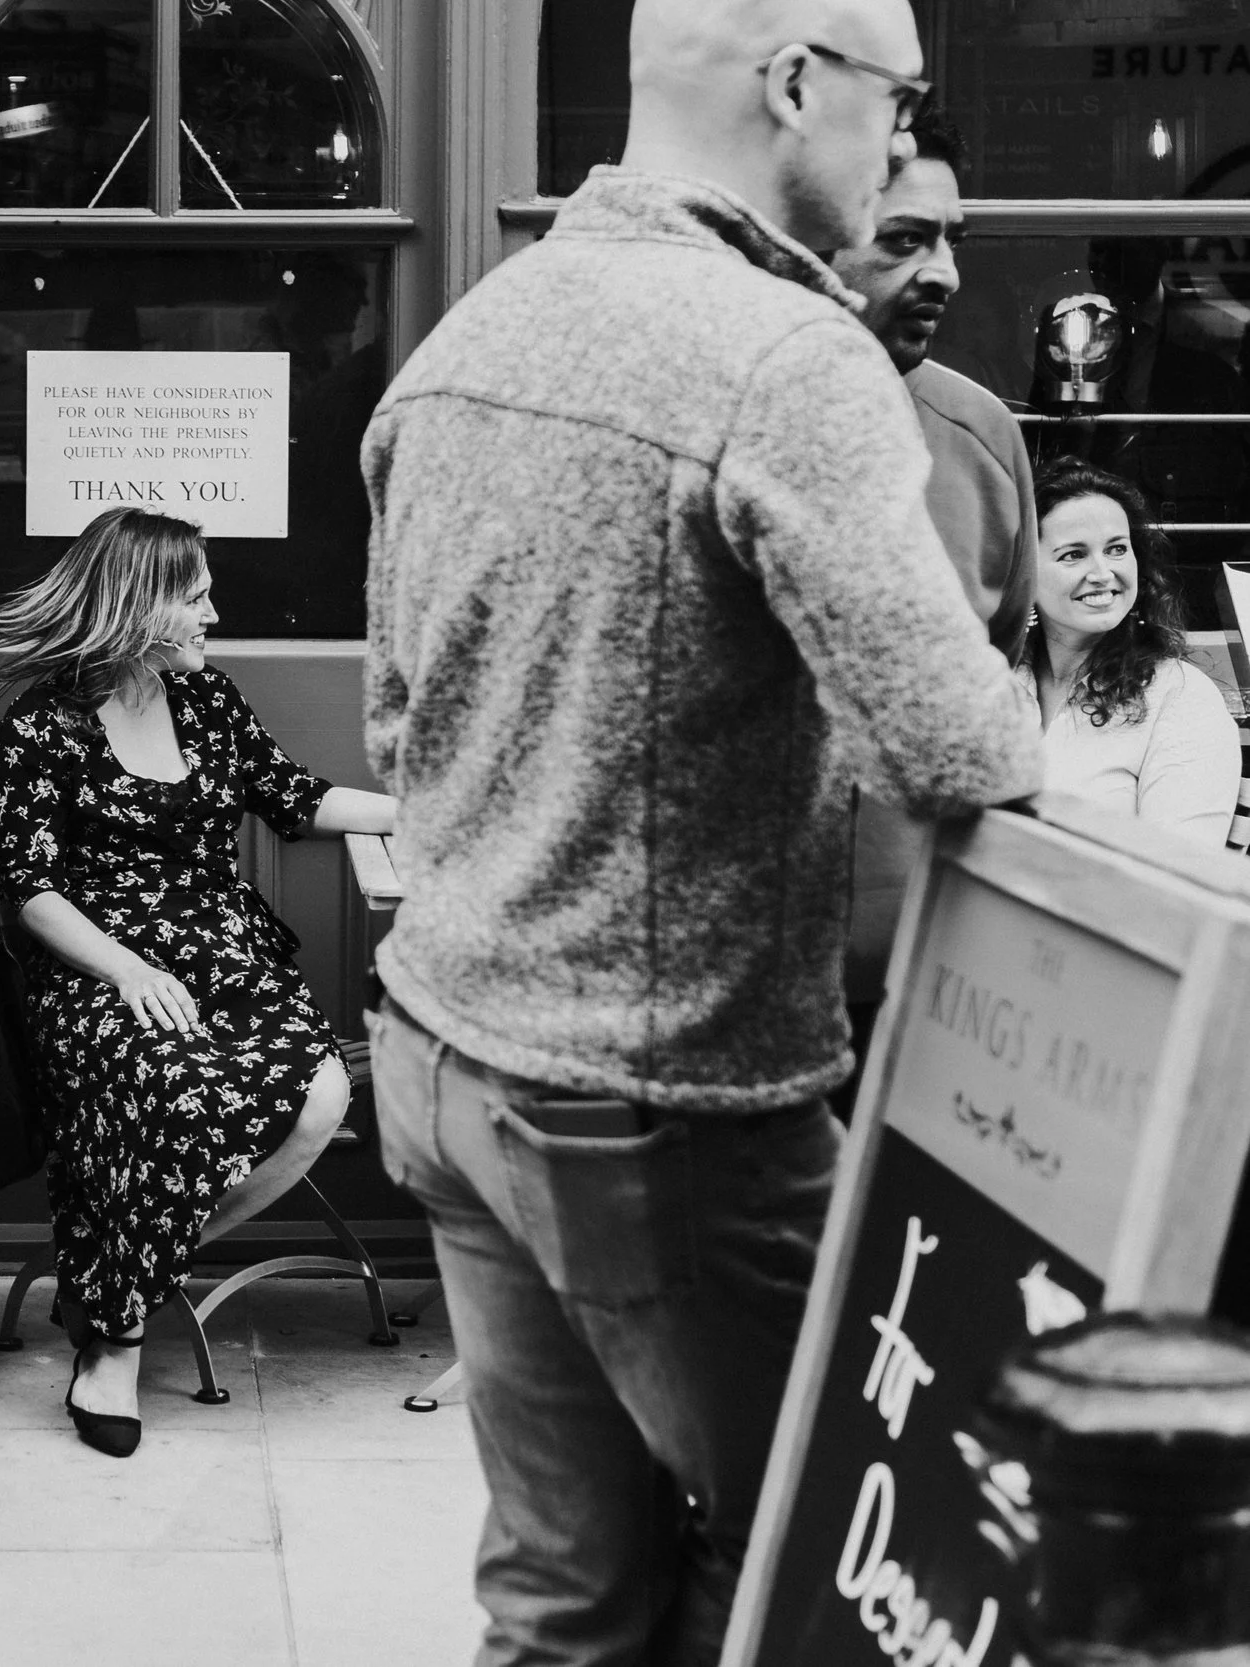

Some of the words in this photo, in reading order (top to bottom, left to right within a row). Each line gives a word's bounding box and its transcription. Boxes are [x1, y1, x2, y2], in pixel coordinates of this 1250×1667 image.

[43, 385, 99, 399] PLEASE
[106, 386, 146, 399] HAVE
[152, 386, 273, 400] CONSIDERATION
[57, 406, 87, 419] FOR
[93, 406, 127, 419] OUR
[133, 406, 231, 420] NEIGHBOURS
[238, 407, 259, 420] BY
[68, 426, 133, 439] LEAVING
[139, 426, 169, 439] THE
[176, 427, 251, 440] PREMISES
[63, 446, 127, 461] QUIETLY
[132, 446, 165, 459] AND
[172, 447, 253, 460] PROMPTLY.
[67, 479, 166, 502] THANK
[178, 480, 245, 503] YOU.
[928, 963, 1035, 1072] KINGS
